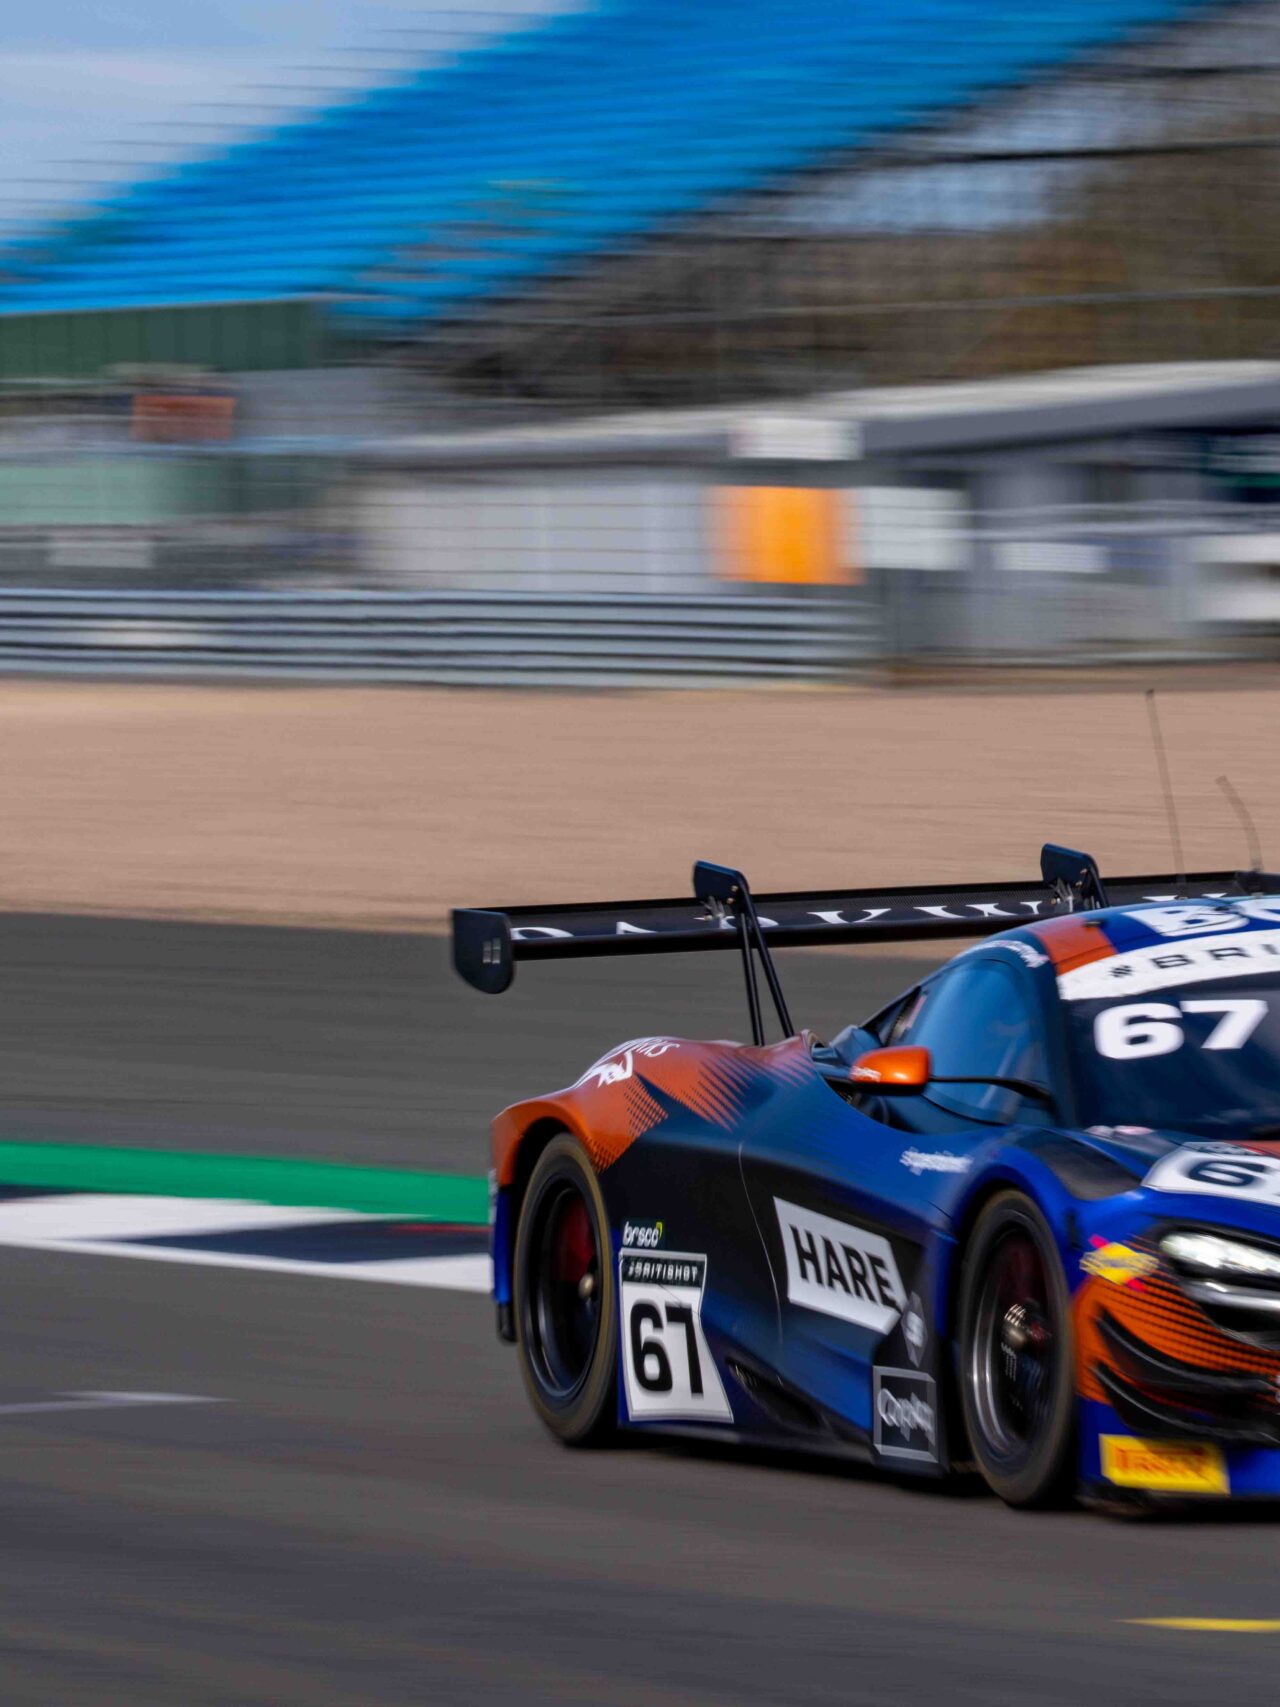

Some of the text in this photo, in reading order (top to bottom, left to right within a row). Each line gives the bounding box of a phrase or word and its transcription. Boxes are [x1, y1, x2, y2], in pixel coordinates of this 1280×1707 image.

[1094, 999, 1269, 1060] 67
[789, 1224, 901, 1313] HARE
[630, 1300, 704, 1399] 67
